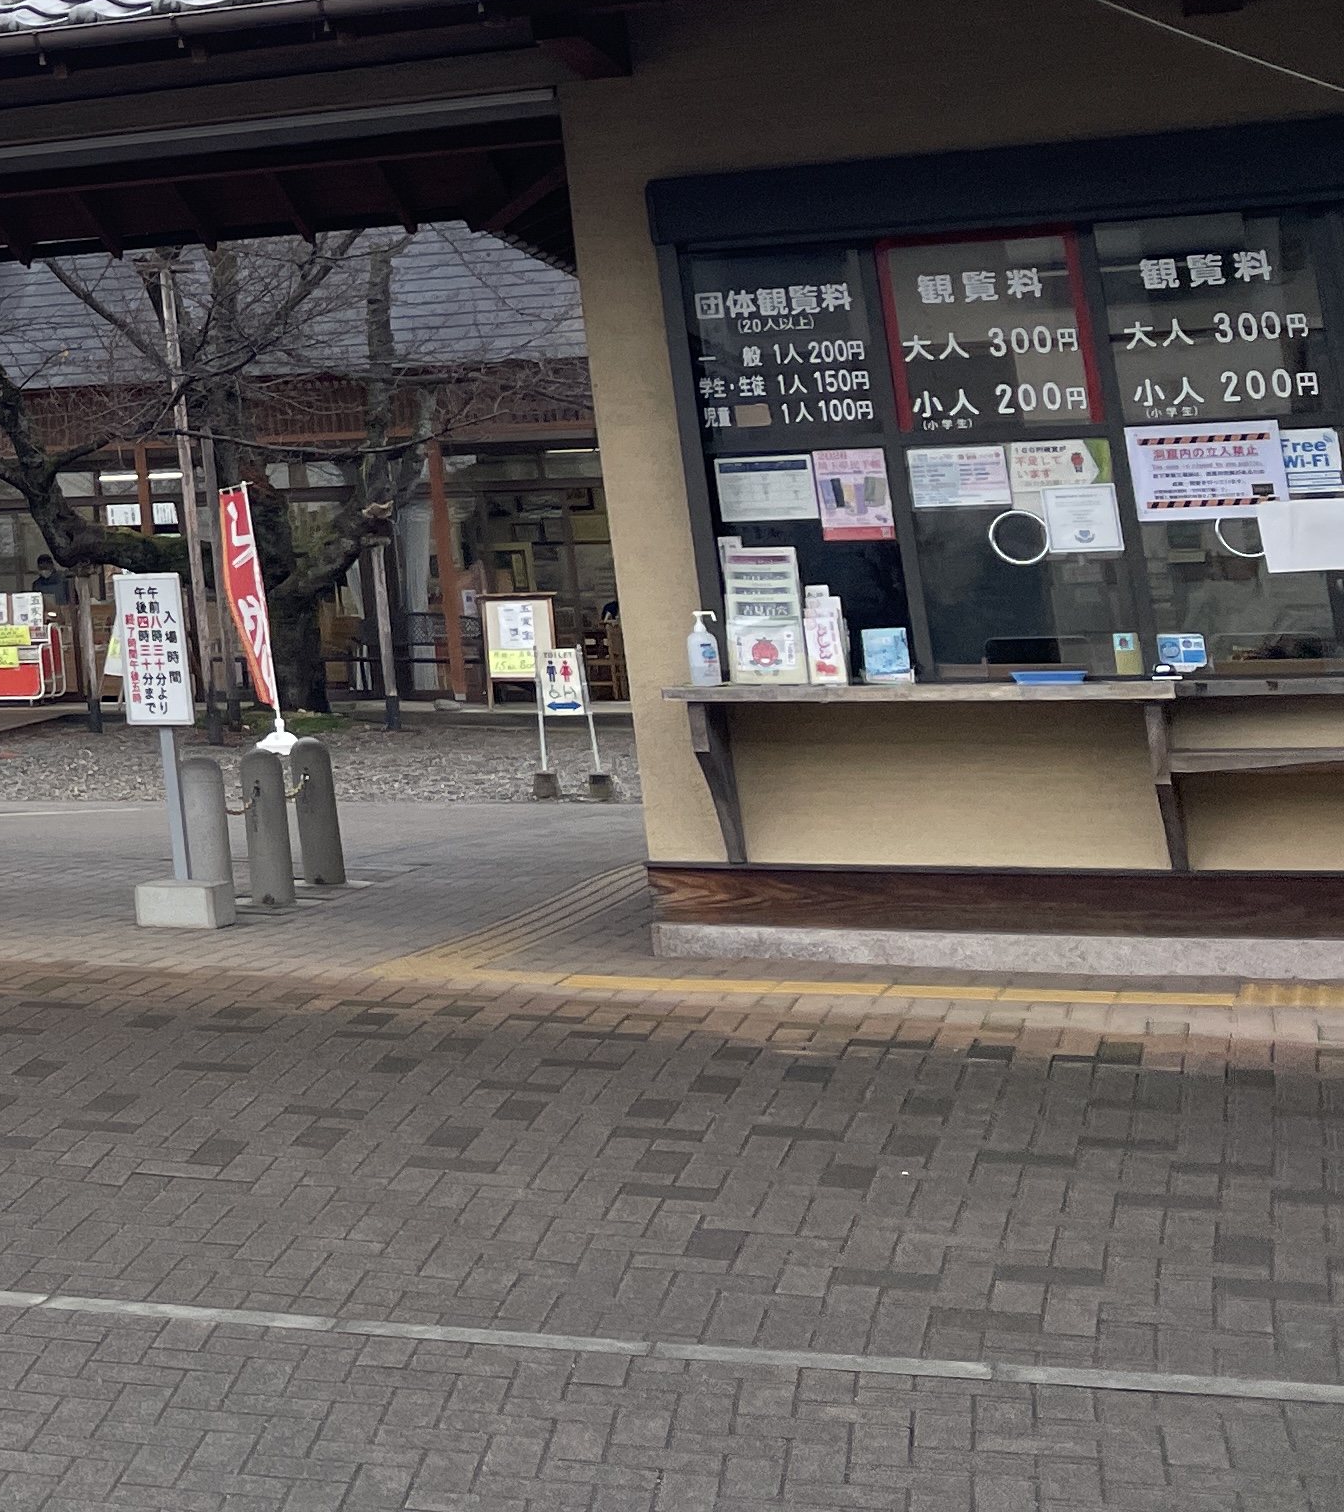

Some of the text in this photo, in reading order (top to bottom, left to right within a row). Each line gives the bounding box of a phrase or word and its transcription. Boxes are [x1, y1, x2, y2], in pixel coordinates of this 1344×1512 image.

[917, 267, 1043, 304] 観覧料
[1139, 249, 1272, 290] 観覧料
[695, 282, 852, 320] 団体観覧料
[902, 325, 1079, 363] 大人 300円
[1123, 311, 1309, 350] 大人 300円
[913, 381, 1087, 418] 小人 200円
[1133, 368, 1319, 407] 小人 200円
[1280, 438, 1327, 453] Free
[1283, 453, 1330, 469] Wi-Fi
[134, 586, 157, 715] 午後四時三十分まで
[147, 586, 168, 715] 午前八時三十分より
[163, 611, 182, 684] 入場時間
[543, 651, 572, 659] TOILET
